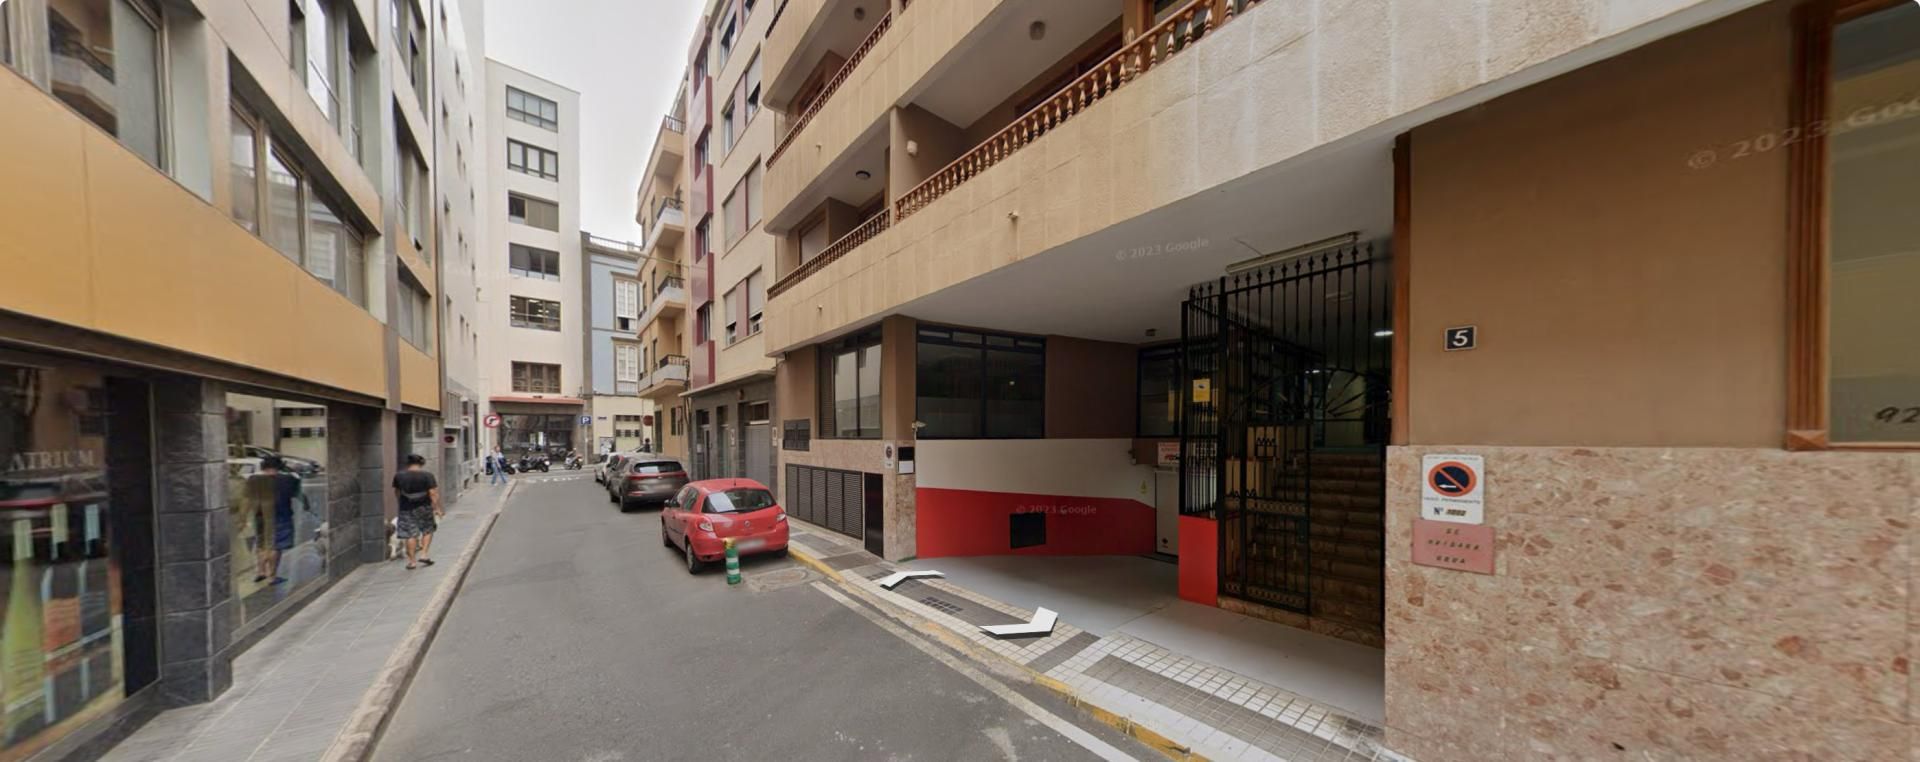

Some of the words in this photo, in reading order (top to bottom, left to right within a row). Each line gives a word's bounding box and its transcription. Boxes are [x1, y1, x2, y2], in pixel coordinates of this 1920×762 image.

[1453, 330, 1469, 347] 5
[582, 416, 590, 424] P
[8, 449, 96, 472] ATRIUM
